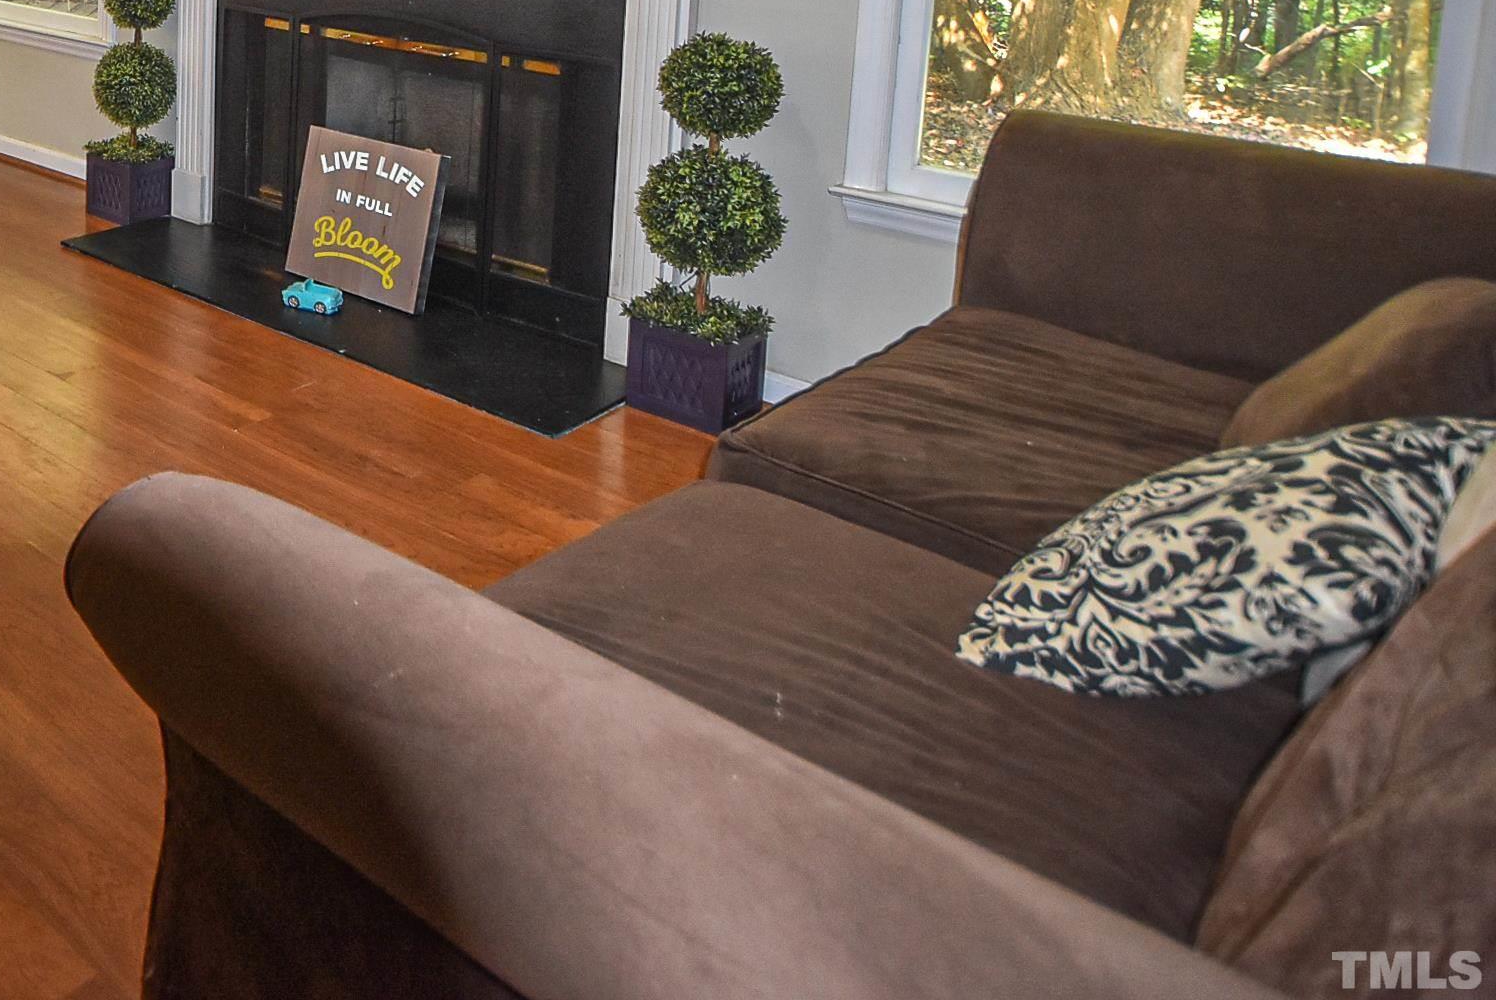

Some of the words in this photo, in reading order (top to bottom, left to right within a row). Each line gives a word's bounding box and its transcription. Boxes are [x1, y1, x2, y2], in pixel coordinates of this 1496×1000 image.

[320, 151, 370, 174] LIVE
[375, 156, 425, 198] LIFE
[336, 189, 352, 204] IN
[355, 195, 393, 217] FULL
[312, 215, 402, 288] Bloom
